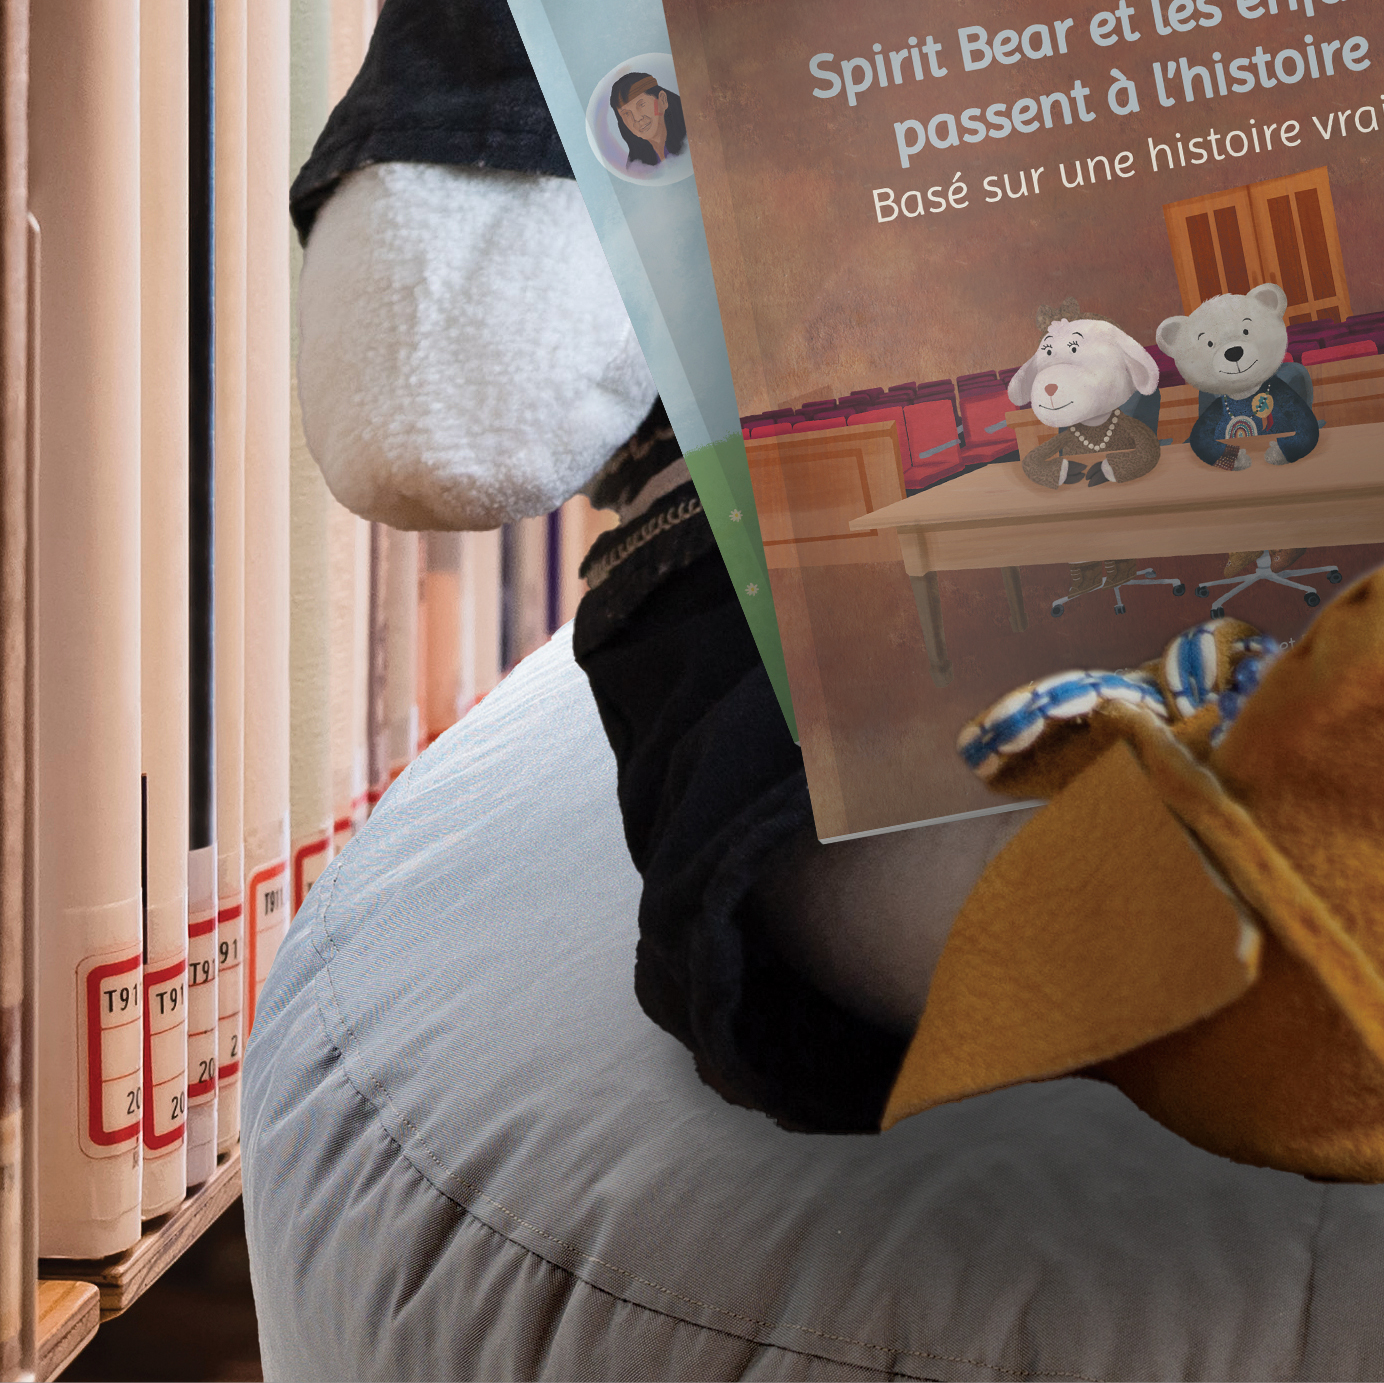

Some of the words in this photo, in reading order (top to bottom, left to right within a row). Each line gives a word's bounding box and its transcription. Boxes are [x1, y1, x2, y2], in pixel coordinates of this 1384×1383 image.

[808, 36, 948, 106] Spirit
[958, 17, 1075, 72] Bear
[1089, 0, 1141, 47] et
[893, 79, 1096, 169] passent
[1106, 68, 1140, 116] à
[1153, 33, 1371, 109] l’histoire
[871, 171, 969, 224] Basé
[983, 166, 1045, 203] sur
[1058, 150, 1135, 190] une
[1148, 117, 1301, 173] histoire
